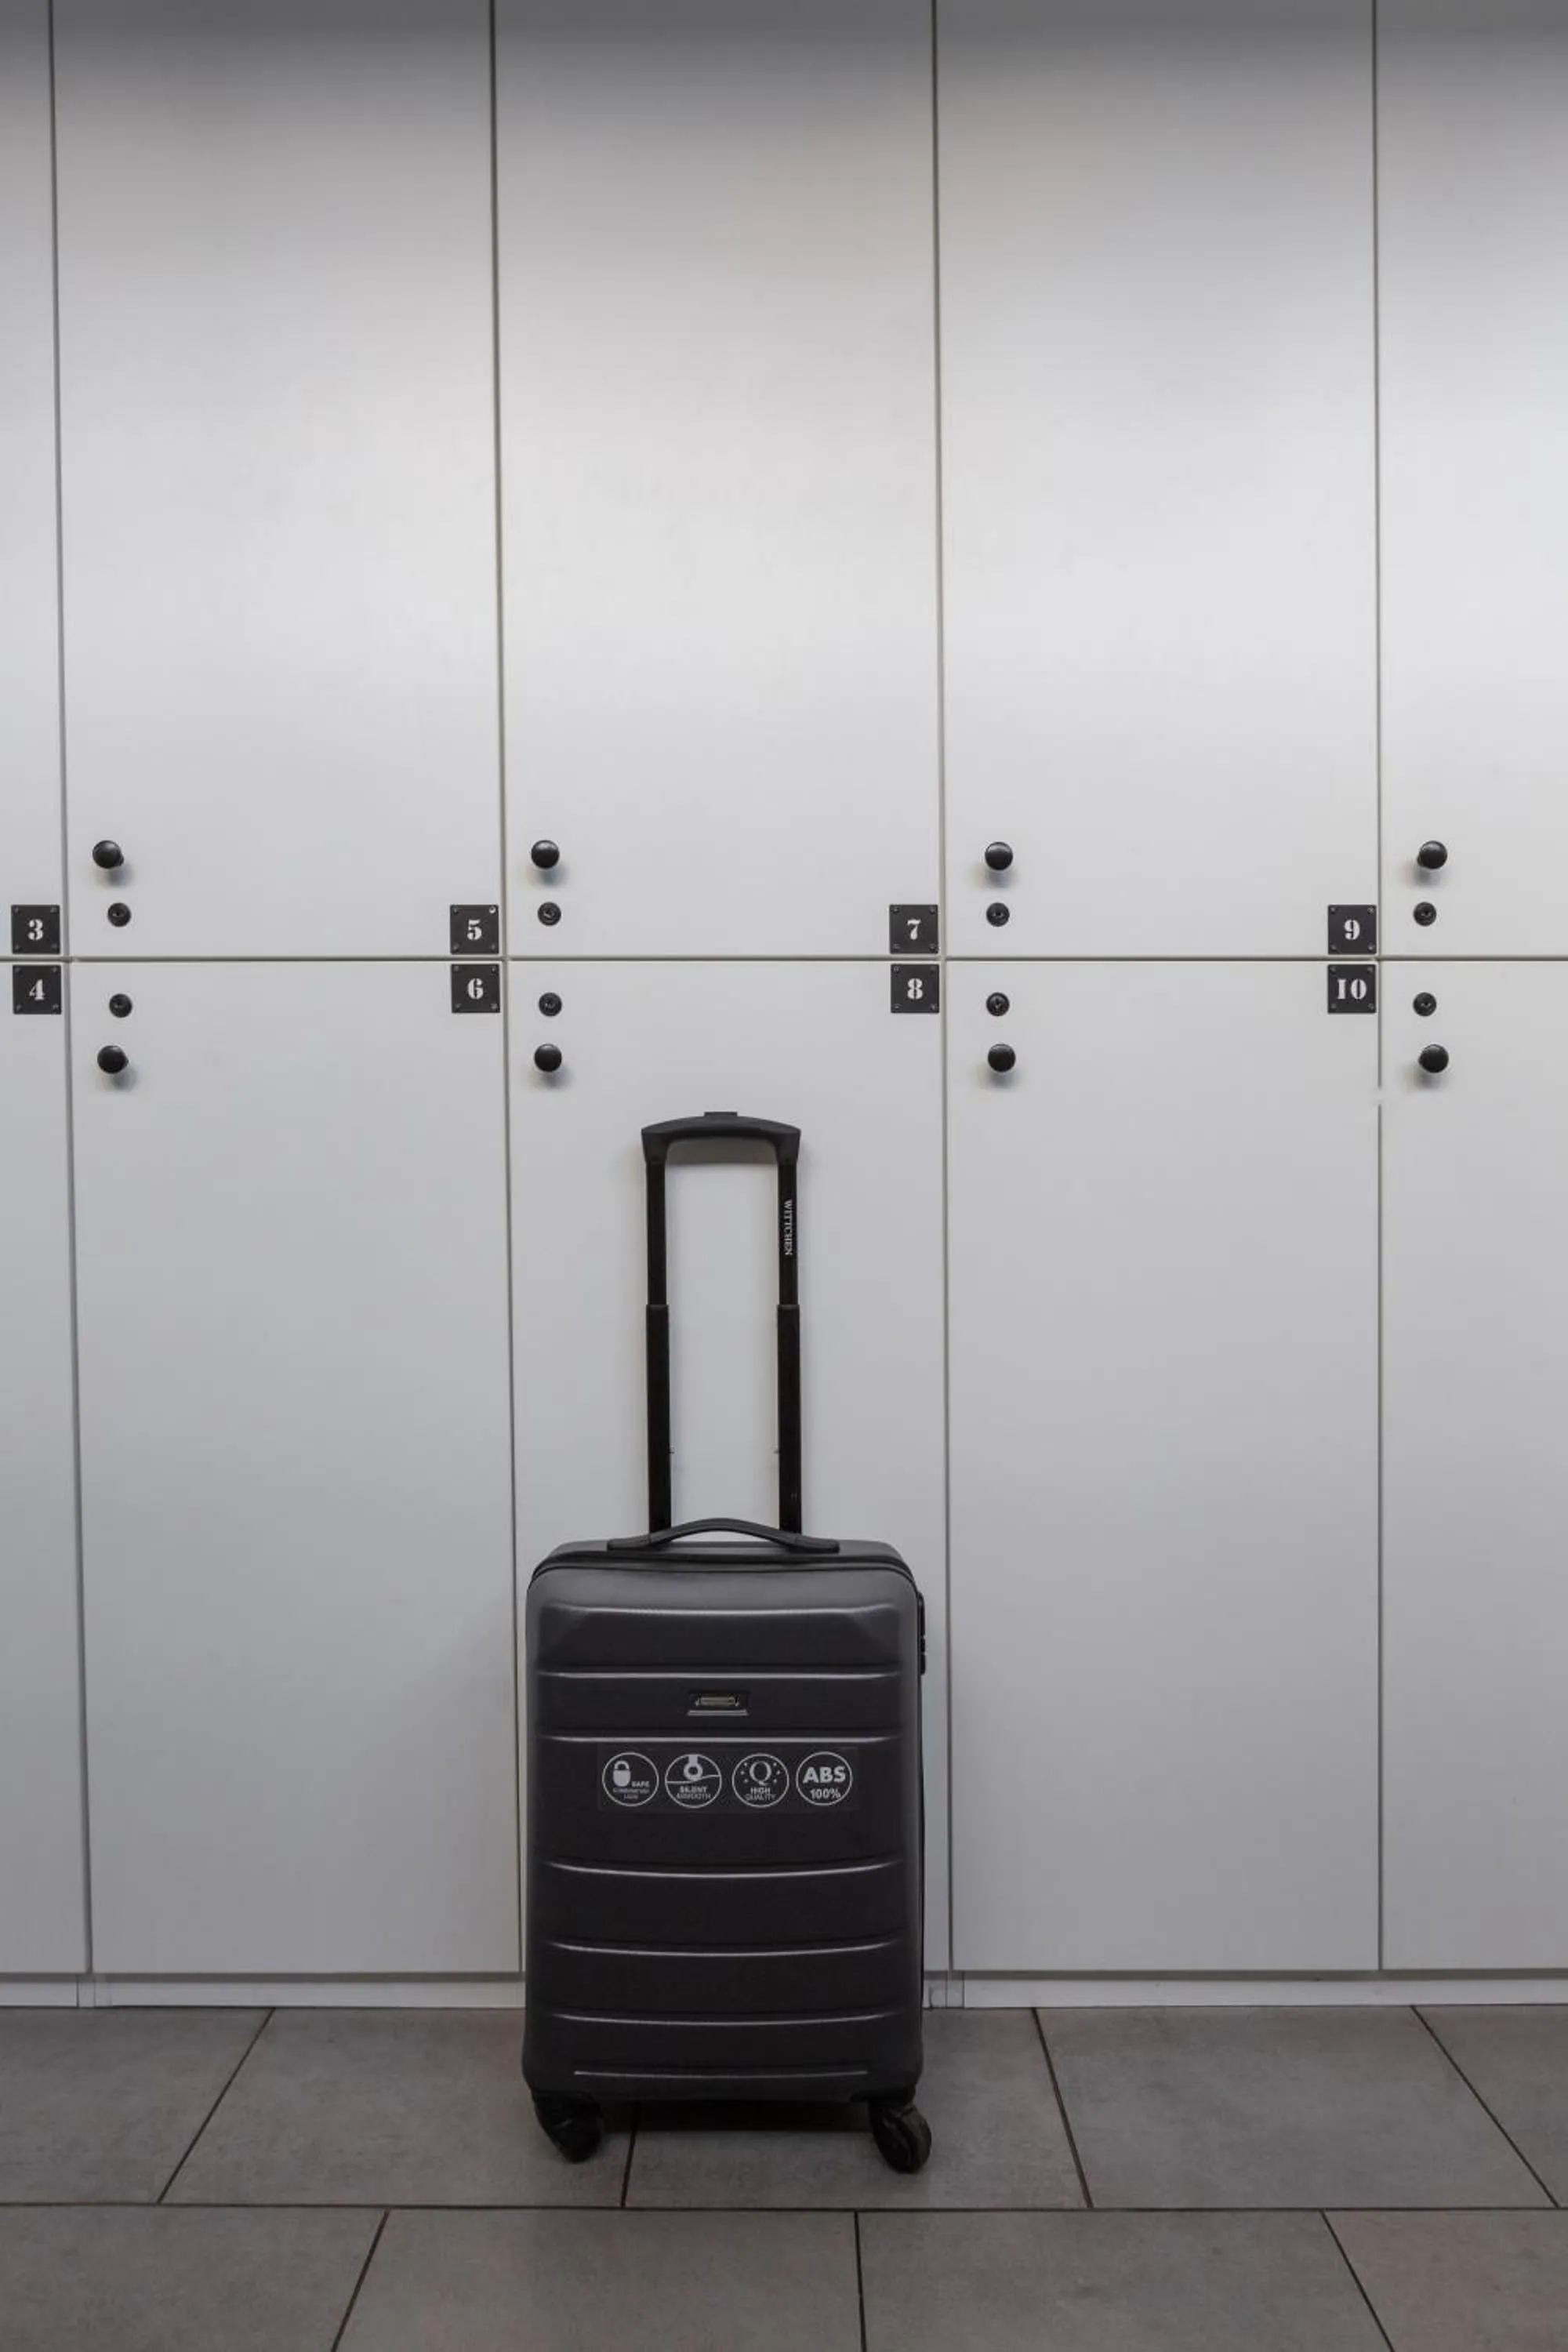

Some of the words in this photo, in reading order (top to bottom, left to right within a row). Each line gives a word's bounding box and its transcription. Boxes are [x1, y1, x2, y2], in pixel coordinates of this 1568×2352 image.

[27, 919, 43, 941] 3
[466, 919, 482, 941] 5
[906, 919, 921, 940] 7
[1344, 919, 1360, 940] 9
[29, 979, 45, 1000] 4
[467, 978, 484, 1000] 6
[907, 978, 924, 1000] 8
[1338, 978, 1367, 1000] 10
[784, 1200, 793, 1255] WITTCHEN
[802, 1766, 846, 1784] ABS
[810, 1788, 841, 1800] 100%
